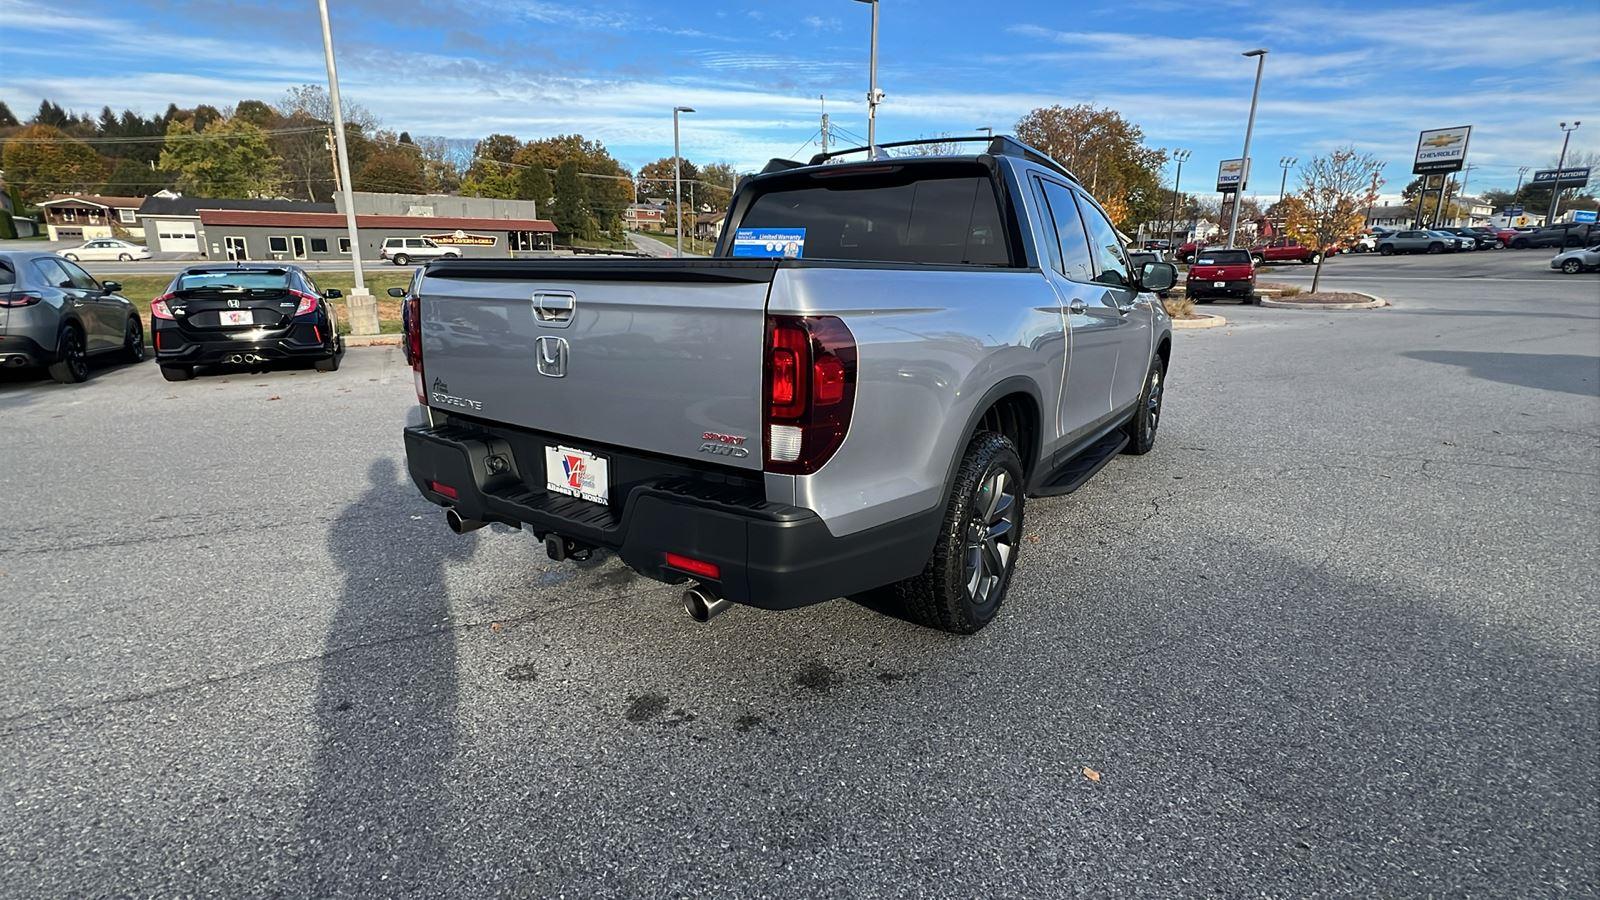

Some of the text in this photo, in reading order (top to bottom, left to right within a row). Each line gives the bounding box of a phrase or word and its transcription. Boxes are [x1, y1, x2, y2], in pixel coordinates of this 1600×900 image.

[1419, 150, 1460, 159] CHEVROLET
[778, 233, 801, 241] Warranty
[432, 392, 482, 410] RIDGELINE
[702, 432, 746, 446] SPORT
[698, 442, 749, 458] AWD
[582, 492, 608, 506] HONDA
